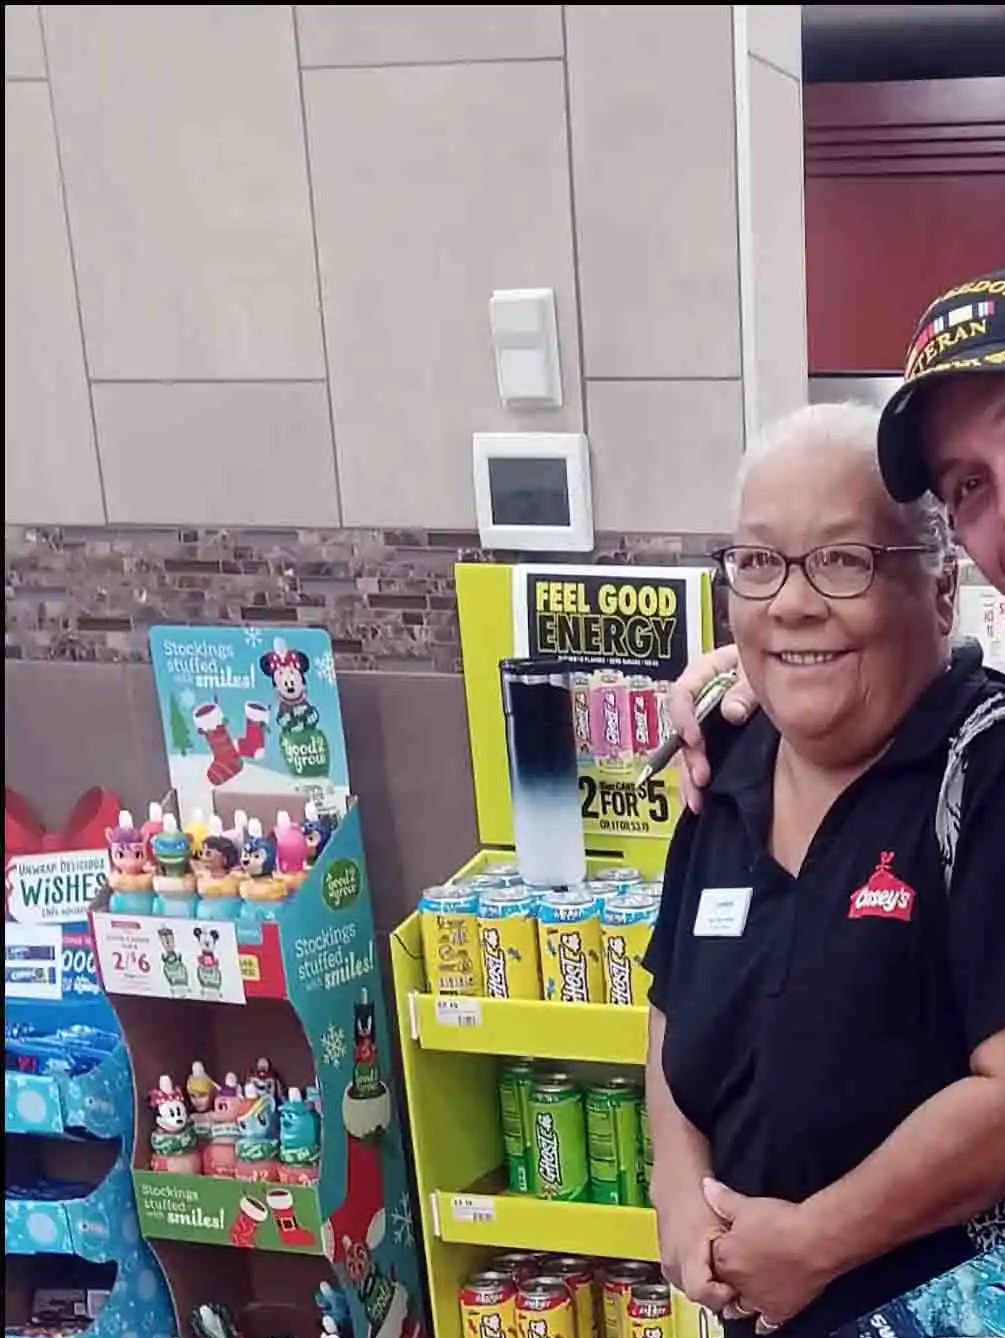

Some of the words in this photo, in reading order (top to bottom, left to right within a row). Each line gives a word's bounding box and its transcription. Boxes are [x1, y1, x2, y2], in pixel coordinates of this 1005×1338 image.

[536, 581, 590, 613] FEEL
[598, 584, 676, 616] GOOD
[536, 612, 676, 659] ENERGY
[163, 639, 234, 662] Stockings
[167, 659, 218, 673] stuffed
[195, 664, 255, 689] smiles!
[578, 775, 599, 818] 2
[600, 792, 640, 817] FOR
[637, 780, 668, 822] $5
[18, 861, 57, 876] UNWRAP
[60, 859, 105, 873] DELICIOUS
[855, 887, 910, 911] Casey's
[295, 922, 357, 958] Stockings
[297, 950, 343, 981] stuffed
[324, 941, 375, 990] smiles!
[536, 1124, 563, 1185] GHOST
[142, 1184, 198, 1201] Stockings
[167, 1208, 225, 1229] smiles!
